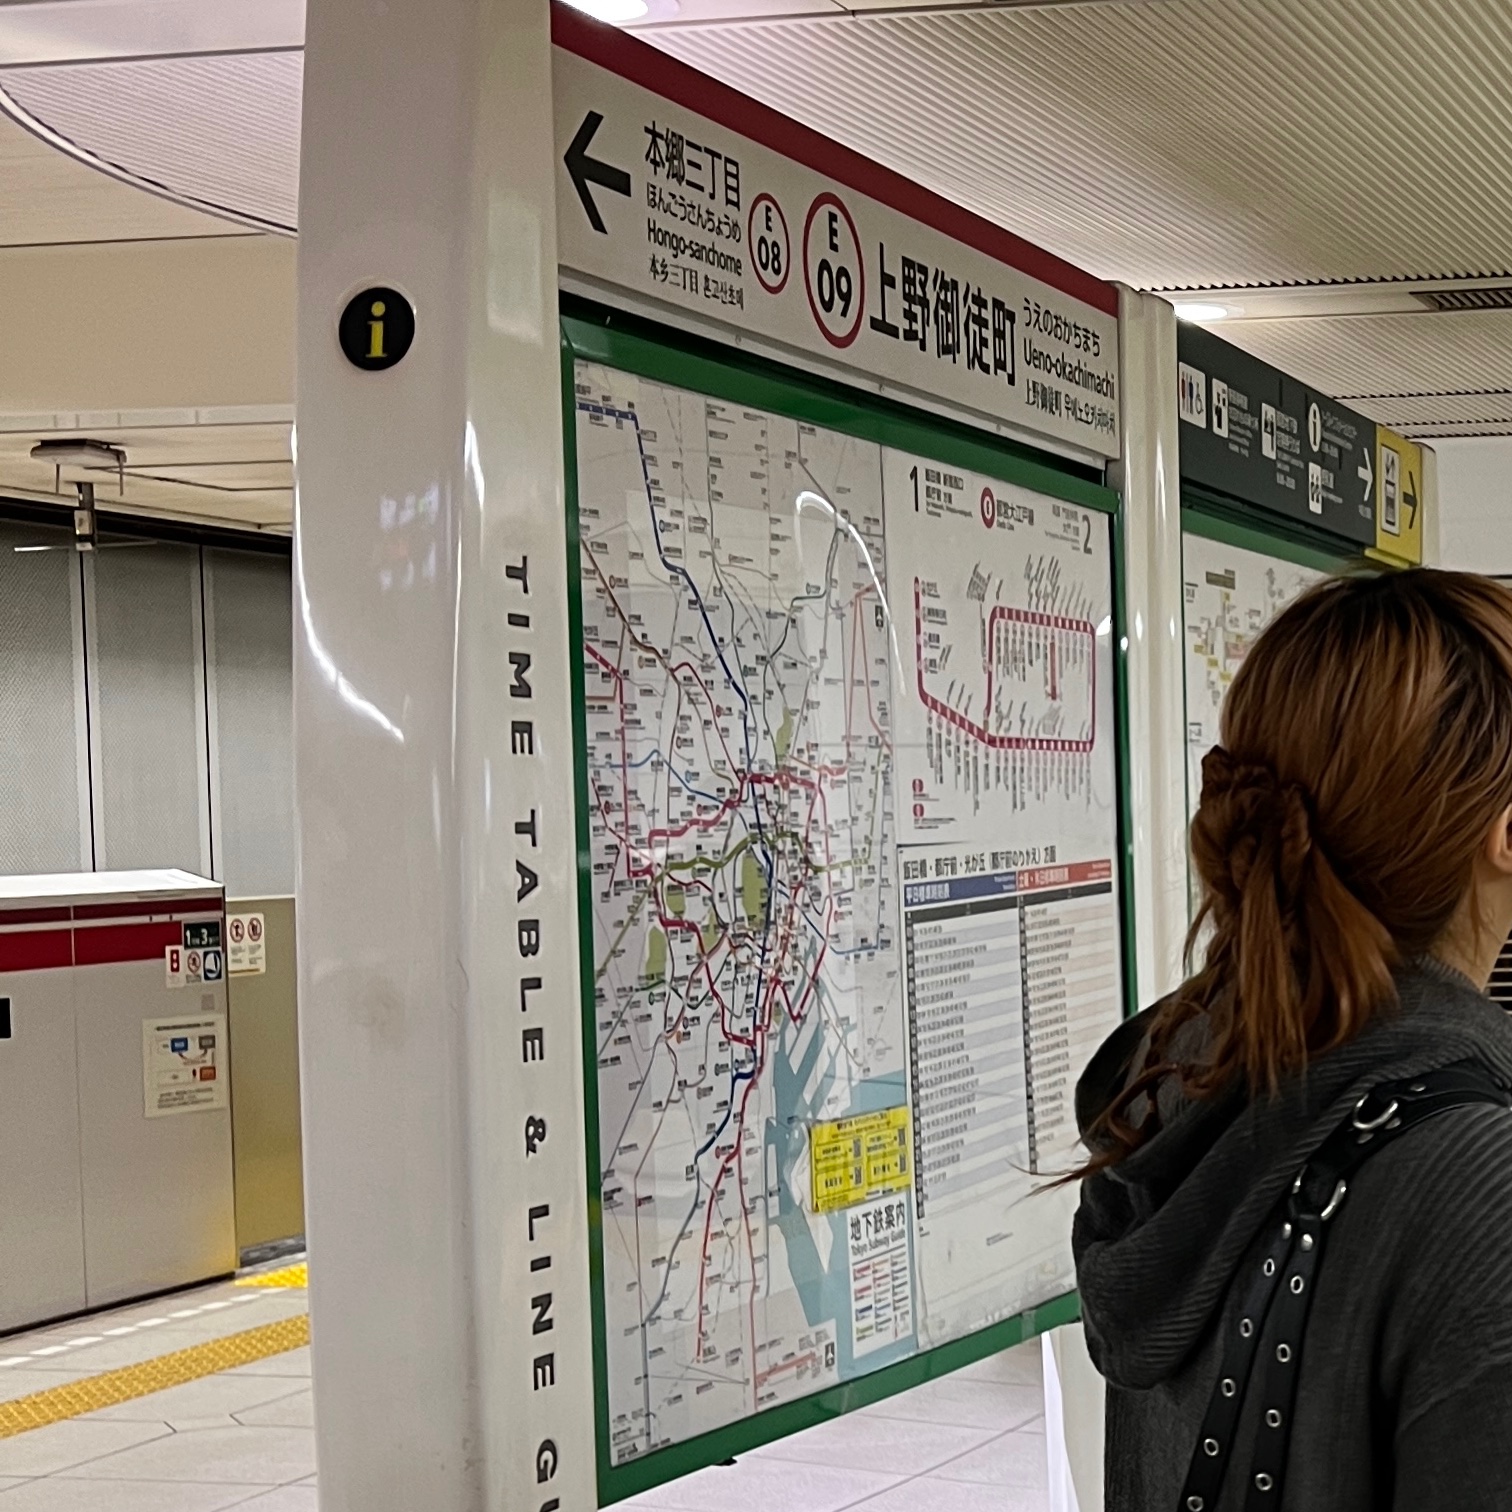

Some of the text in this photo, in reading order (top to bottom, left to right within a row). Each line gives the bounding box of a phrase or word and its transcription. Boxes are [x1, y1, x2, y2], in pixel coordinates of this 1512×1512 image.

[644, 120, 741, 212] 本郷三丁目
[647, 182, 742, 243] ほんごうさんちょうめ
[765, 204, 773, 233] E
[828, 210, 839, 253] E
[647, 218, 743, 276] Hongo-sanchome
[757, 235, 782, 276] 08
[817, 258, 852, 318] 09
[869, 241, 1016, 387] 上野御徒町
[1023, 297, 1100, 357] うえのおかちまち
[1023, 337, 1115, 400] Ueno-okachimachi
[909, 465, 919, 512] 1
[1082, 514, 1092, 555] 2
[505, 555, 534, 755] TIME
[185, 929, 192, 946] 1
[201, 928, 208, 945] 3
[514, 808, 545, 1063] TABLE
[526, 1115, 546, 1158] &
[850, 1201, 906, 1241] 地下鉄案内
[528, 1204, 555, 1391] LINE
